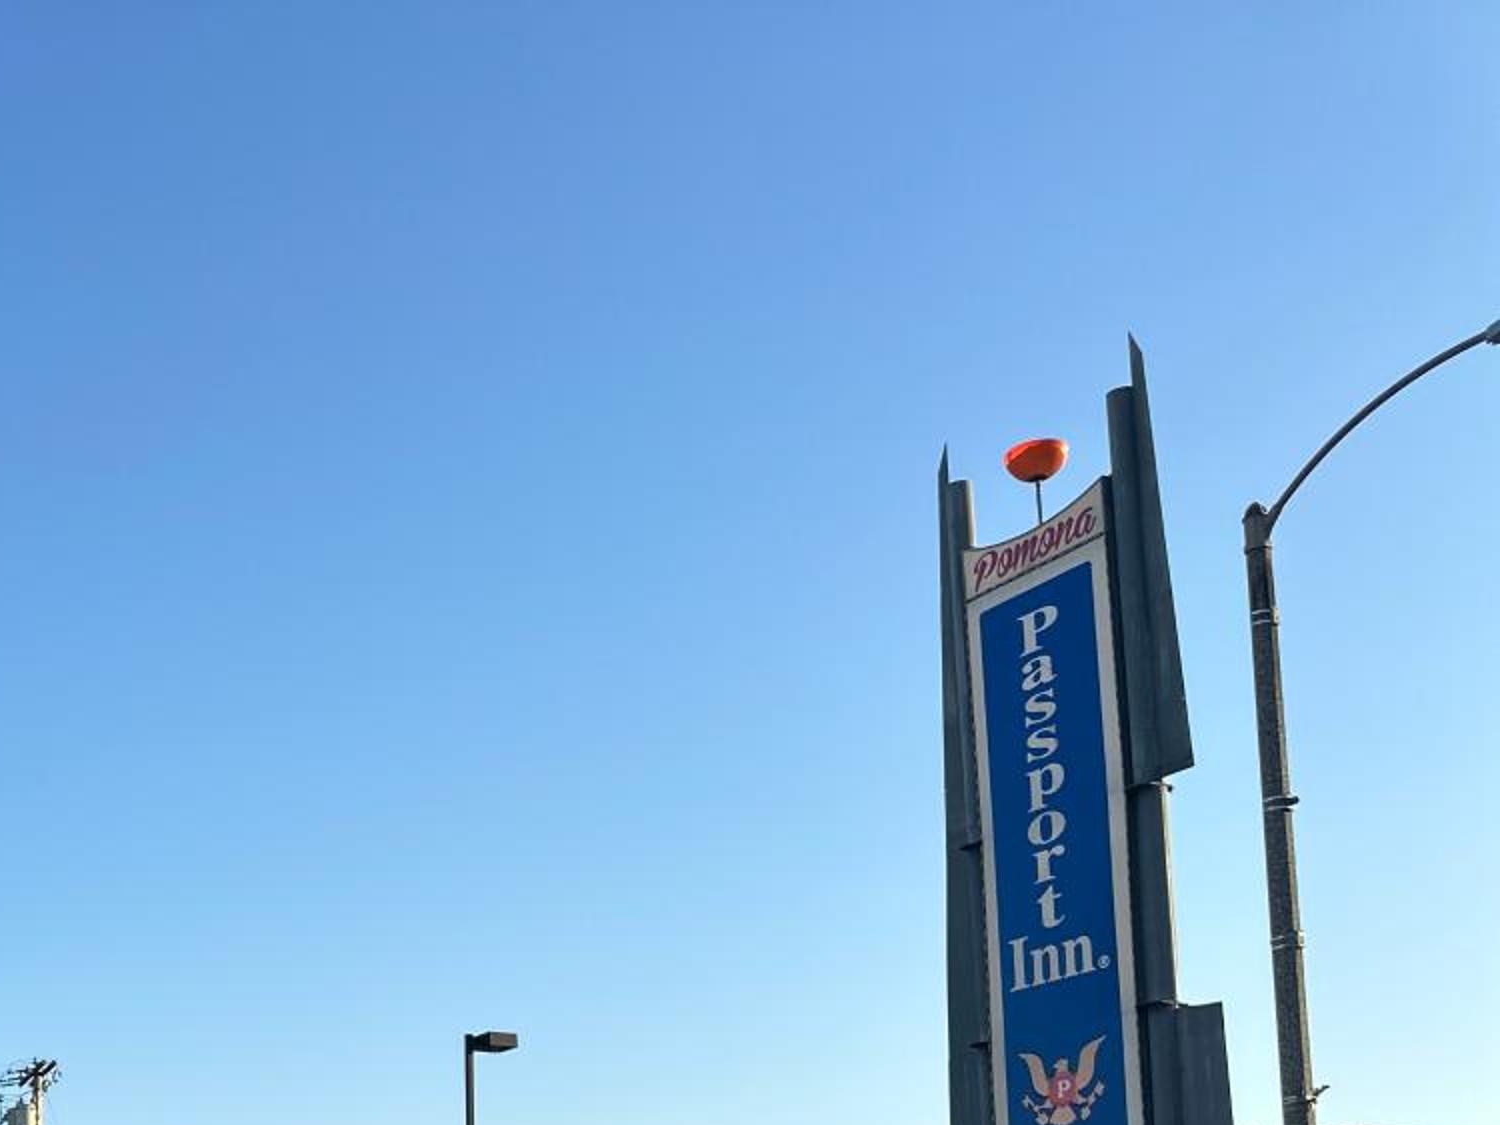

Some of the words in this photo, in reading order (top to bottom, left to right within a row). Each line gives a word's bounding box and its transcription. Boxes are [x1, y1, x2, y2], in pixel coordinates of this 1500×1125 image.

[974, 507, 1096, 592] Pomona
[1017, 605, 1067, 928] Passport
[1057, 1080, 1072, 1099] P
